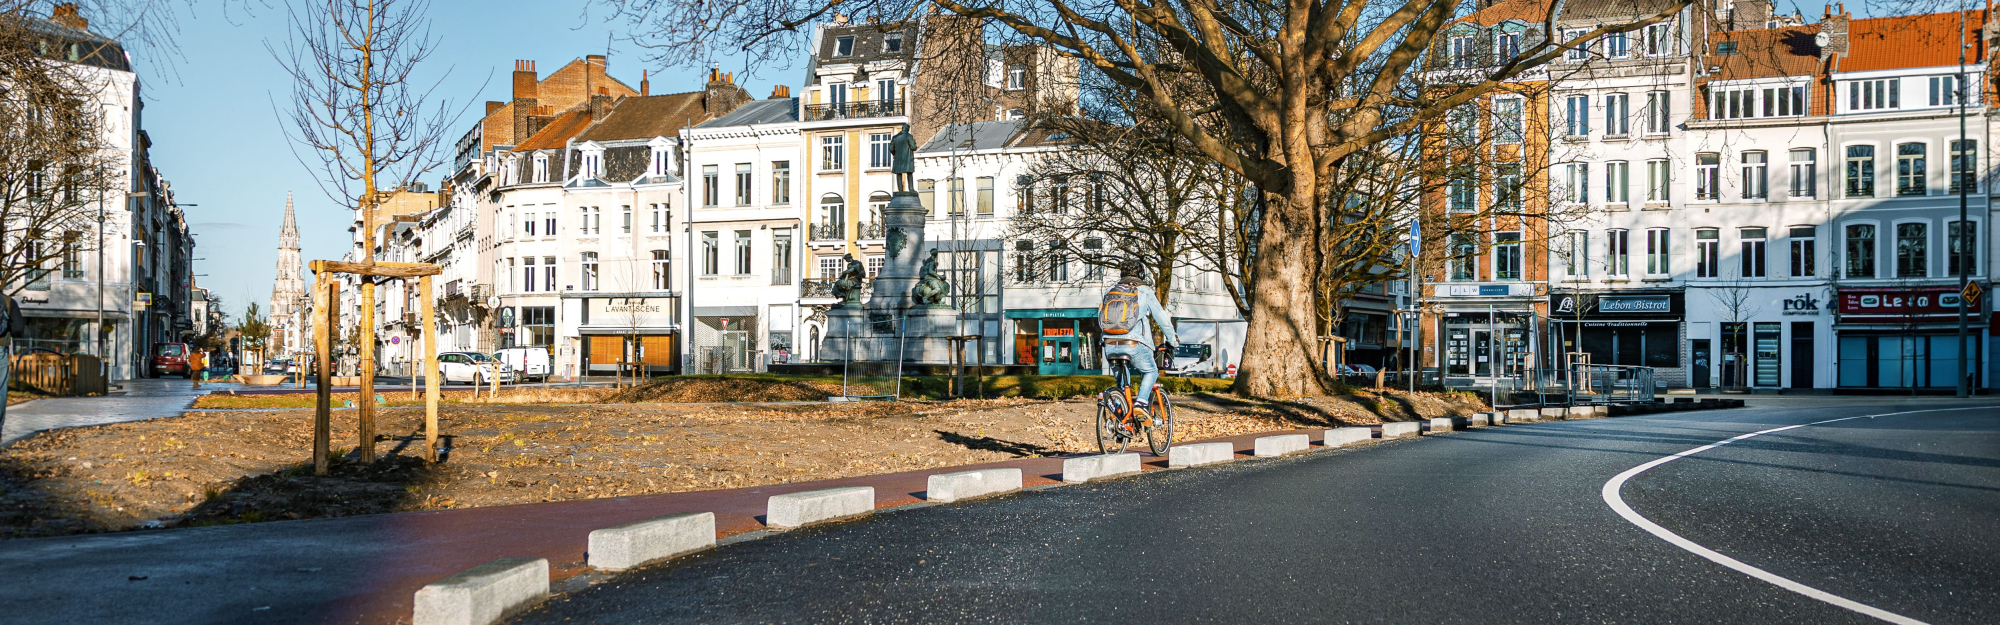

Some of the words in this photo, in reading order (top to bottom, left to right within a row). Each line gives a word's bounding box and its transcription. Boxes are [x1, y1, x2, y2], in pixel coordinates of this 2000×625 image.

[1602, 300, 1631, 310] Lebon
[1633, 300, 1667, 310] Bistrot
[1783, 293, 1820, 310] rök
[1043, 328, 1074, 336] TRIPLETTA
